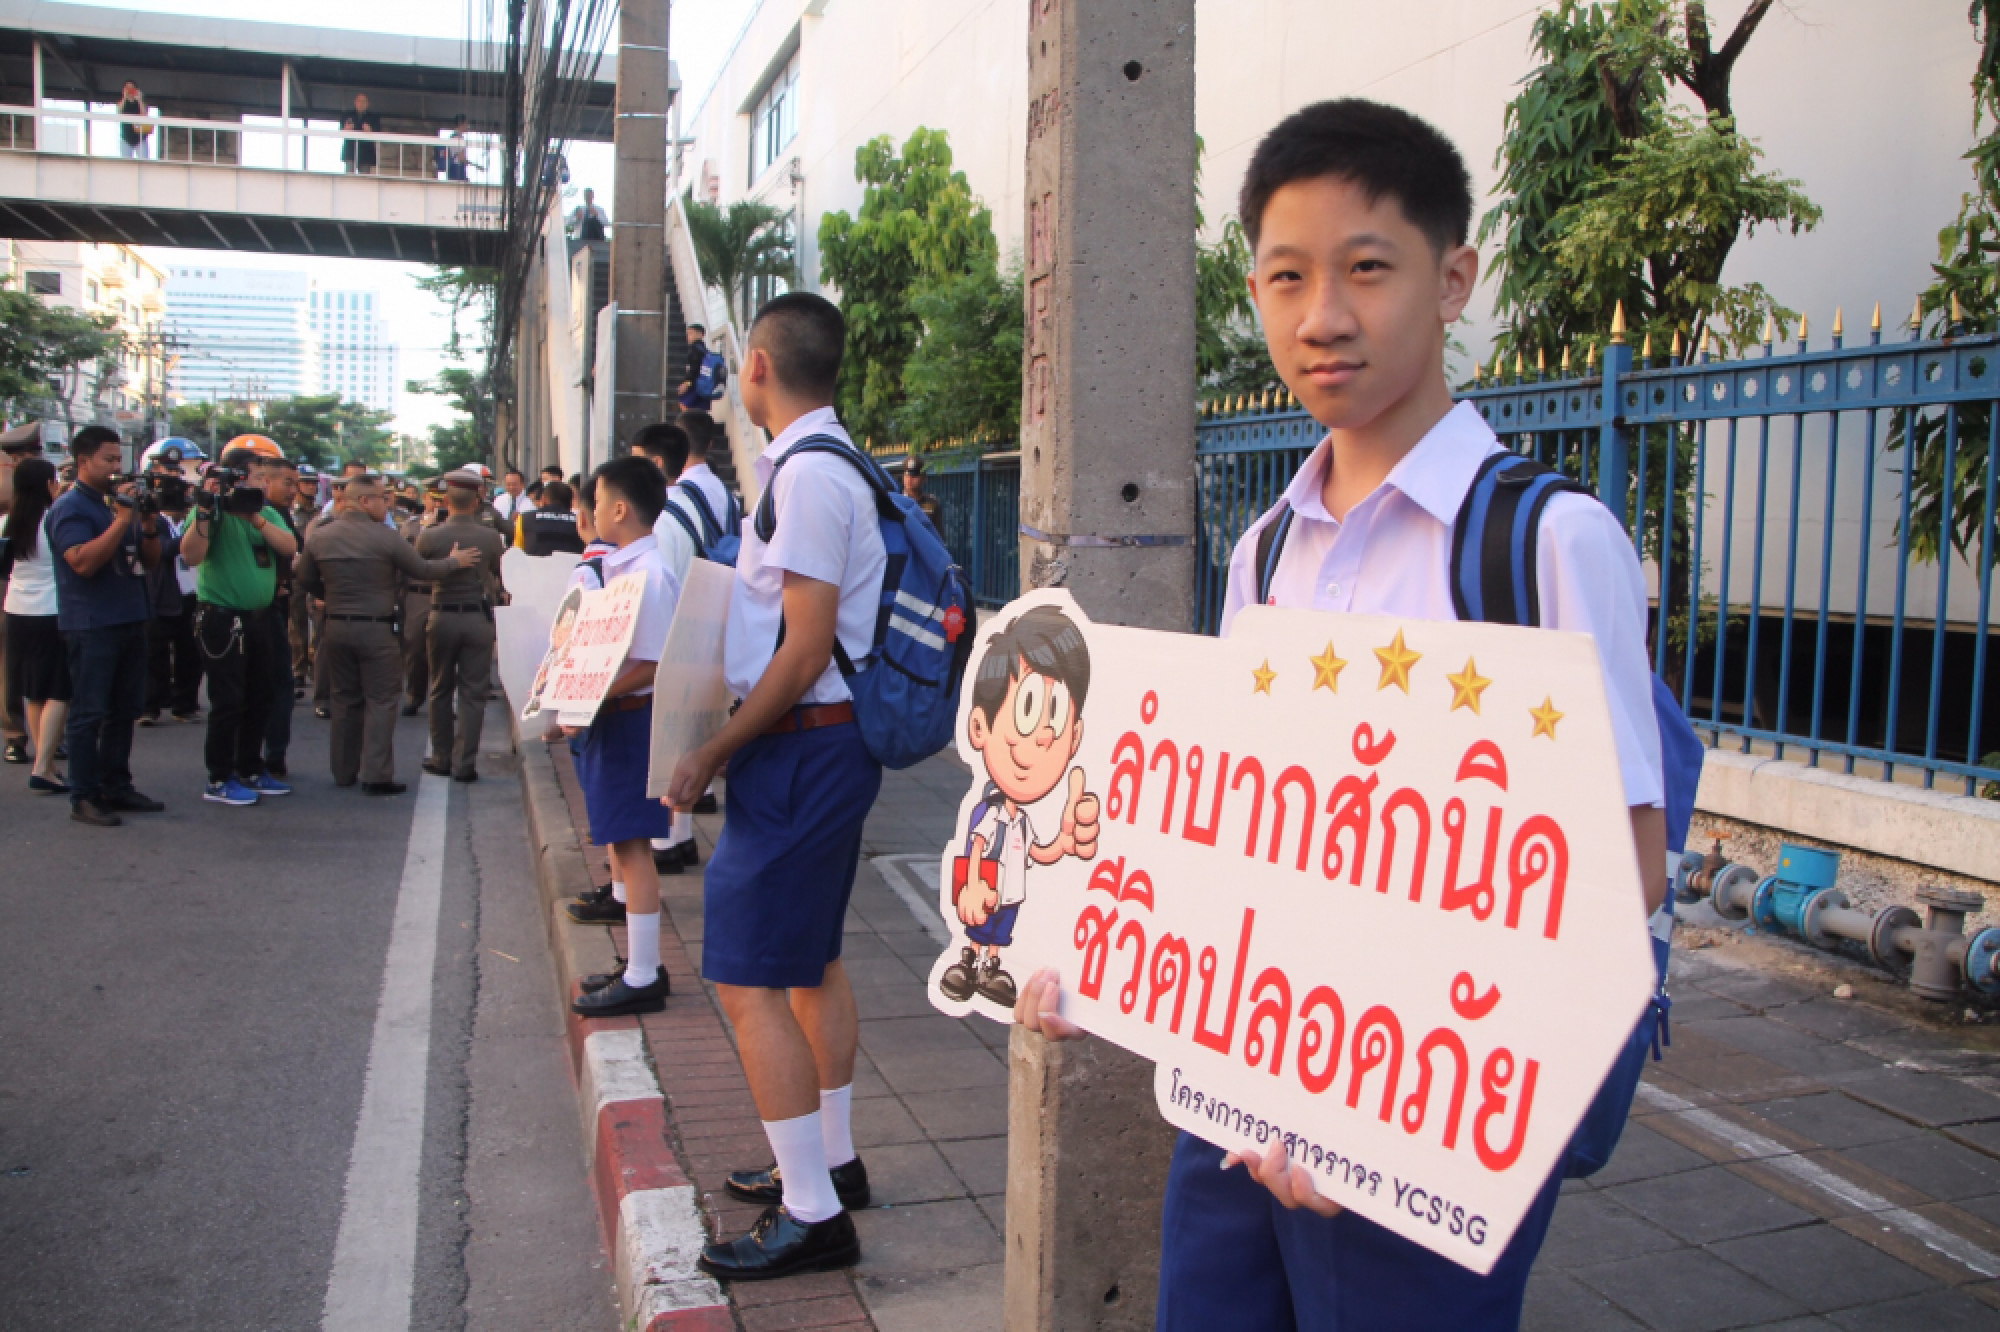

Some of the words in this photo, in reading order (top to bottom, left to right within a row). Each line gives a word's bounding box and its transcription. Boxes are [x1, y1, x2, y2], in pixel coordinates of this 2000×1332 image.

[1105, 689, 1571, 942] ลำบากสักนิด
[1072, 856, 1542, 1174] ชีวิตปลอดภัย
[1393, 1175, 1488, 1246] YCS'SG
